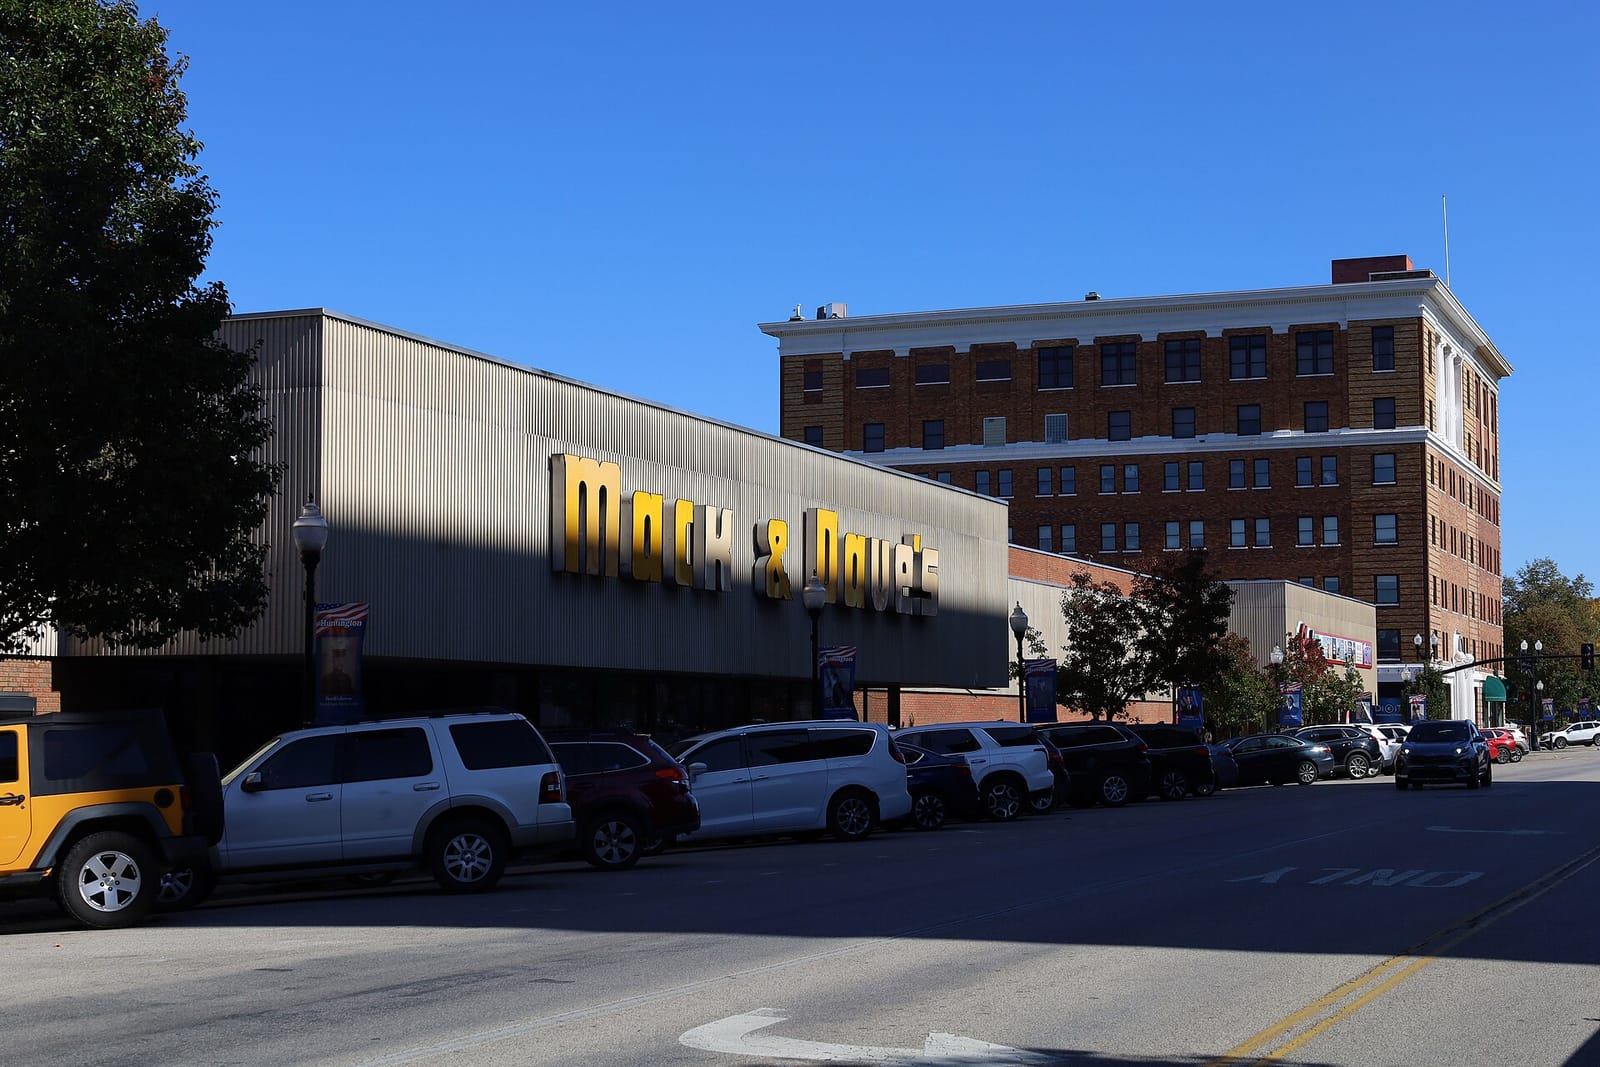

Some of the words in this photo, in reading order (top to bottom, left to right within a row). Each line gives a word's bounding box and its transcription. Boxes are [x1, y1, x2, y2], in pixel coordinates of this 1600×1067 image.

[552, 453, 733, 592] Mack
[754, 518, 792, 600] &
[804, 508, 939, 616] Dave's
[320, 619, 362, 628] Huntington
[1223, 866, 1486, 888] ONLY
